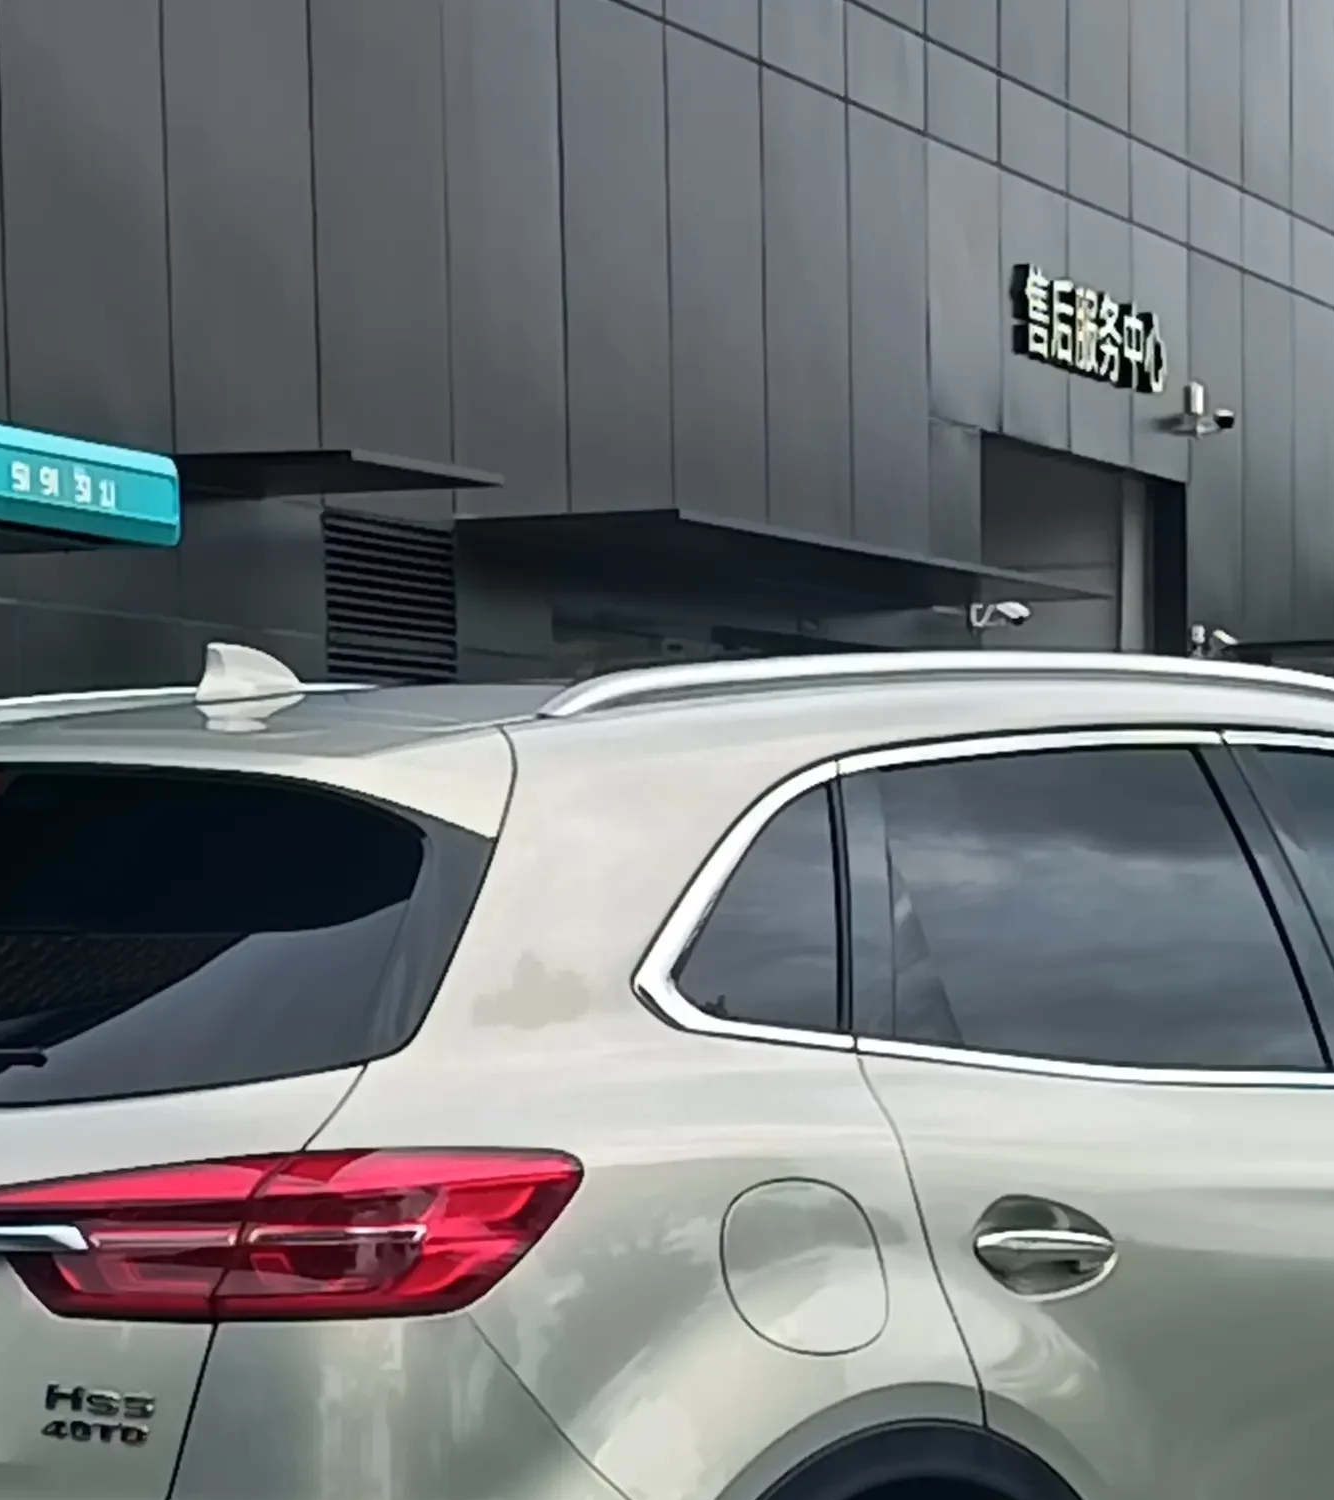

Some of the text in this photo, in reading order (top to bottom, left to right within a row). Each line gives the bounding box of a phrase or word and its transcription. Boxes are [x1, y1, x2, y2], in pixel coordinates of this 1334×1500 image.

[1022, 262, 1168, 393] 售后服务中心
